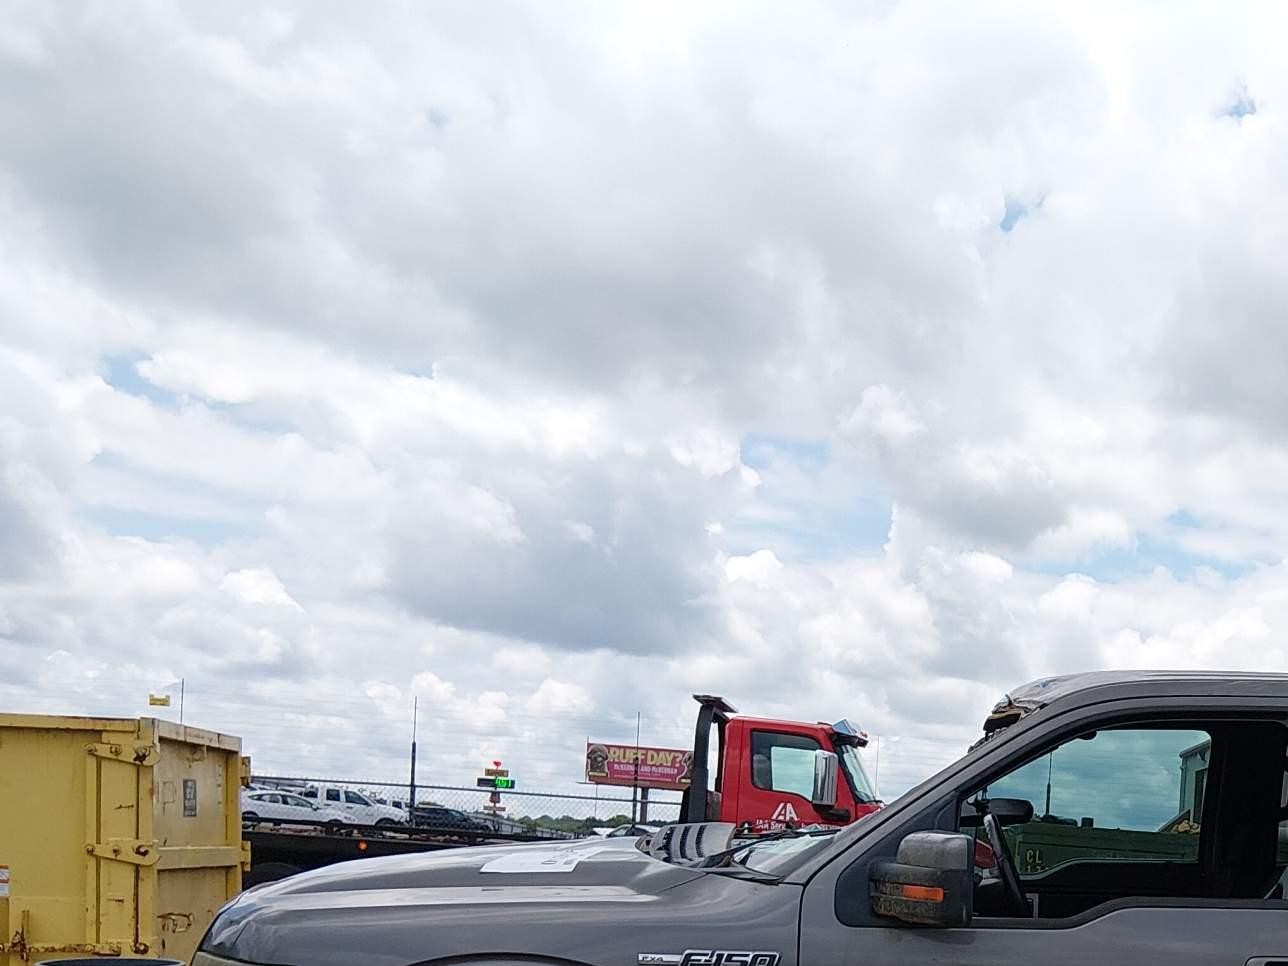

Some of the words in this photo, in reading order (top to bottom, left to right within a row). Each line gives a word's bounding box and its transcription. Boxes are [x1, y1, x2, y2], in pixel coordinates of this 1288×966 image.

[608, 746, 645, 765] RUFF
[647, 750, 682, 767] DAY?
[1026, 849, 1042, 864] CL
